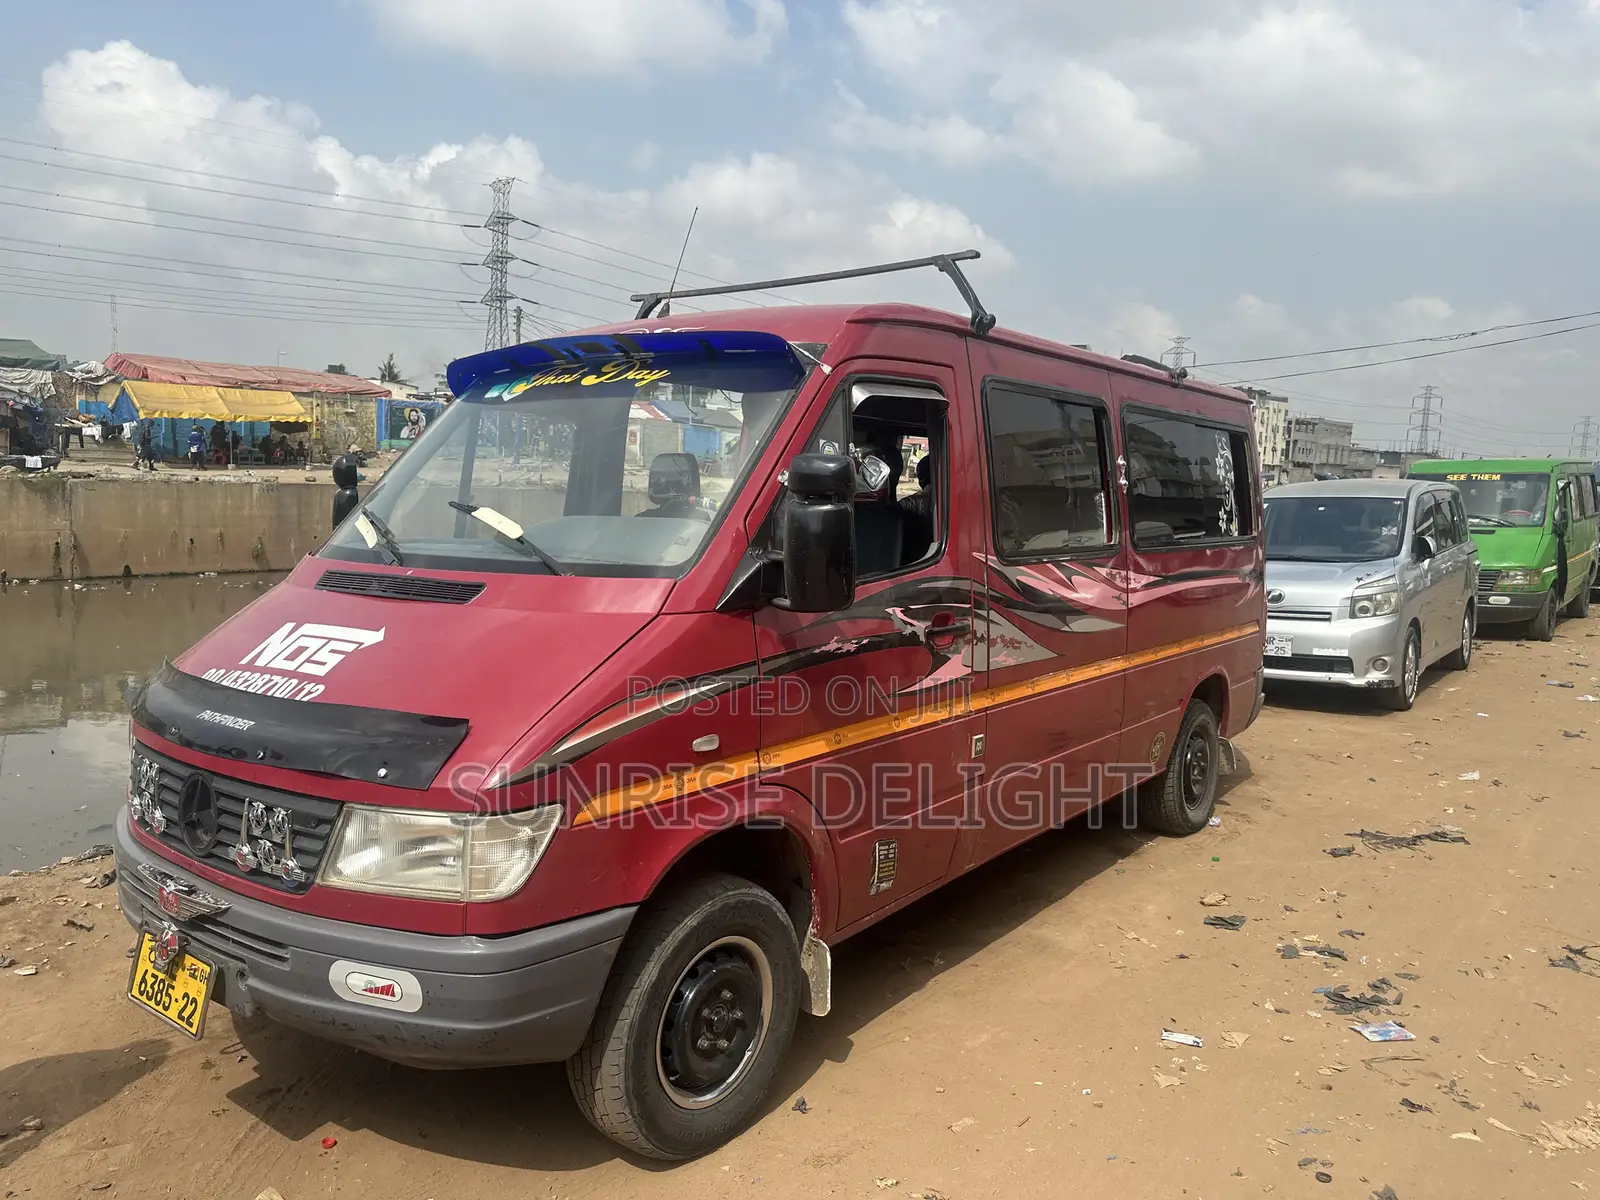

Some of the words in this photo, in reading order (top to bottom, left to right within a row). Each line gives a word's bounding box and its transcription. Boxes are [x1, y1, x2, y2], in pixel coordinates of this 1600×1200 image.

[512, 362, 588, 394] That
[581, 358, 672, 388] Day
[1446, 473, 1468, 481] SEE
[1470, 473, 1501, 481] THEM
[238, 622, 386, 677] NOS
[196, 709, 256, 731] PATHFINDER
[138, 969, 199, 1029] 6385-22
